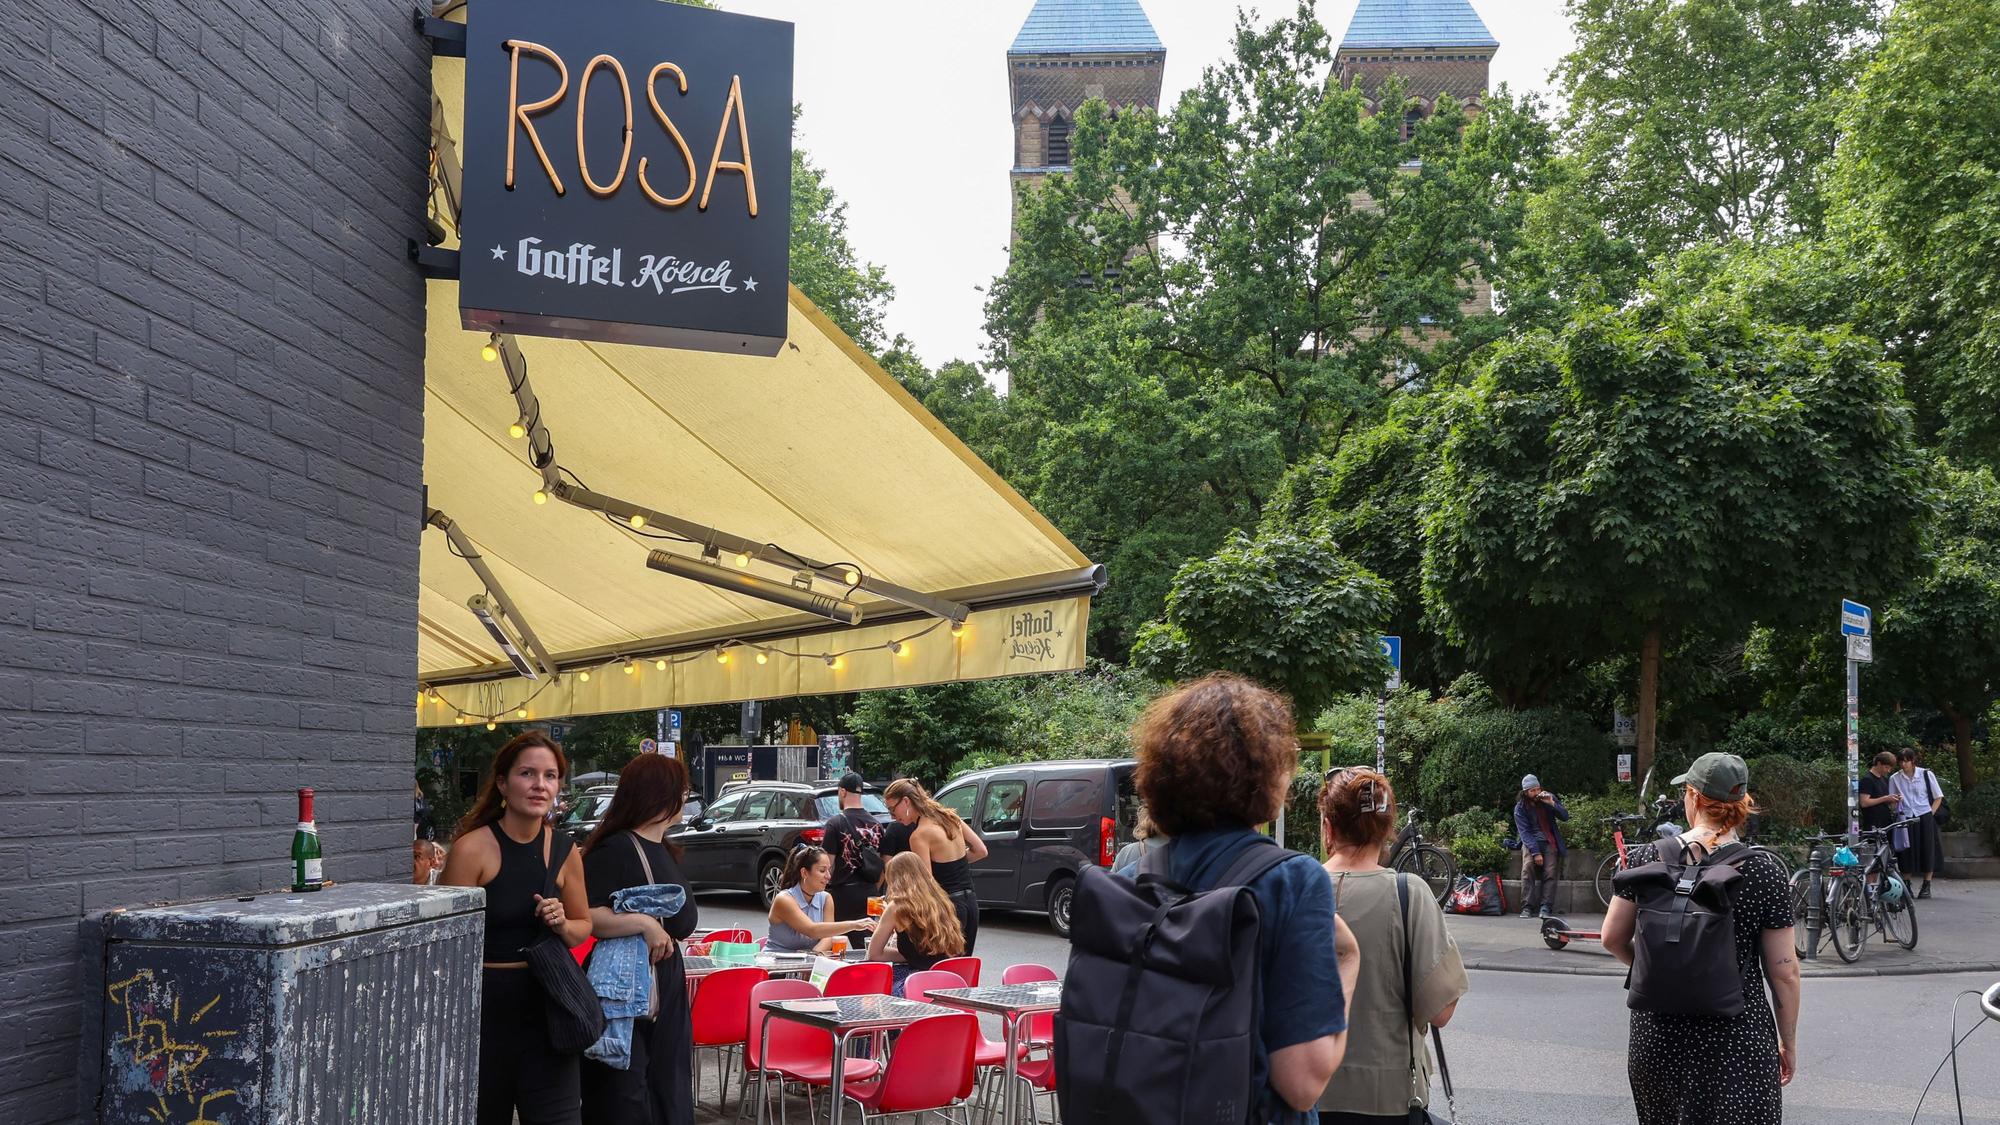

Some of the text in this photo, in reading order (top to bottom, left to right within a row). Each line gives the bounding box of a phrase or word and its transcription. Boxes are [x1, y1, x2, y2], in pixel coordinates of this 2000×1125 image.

[505, 39, 758, 217] ROSA
[517, 236, 738, 295] Gaffel Kölsch
